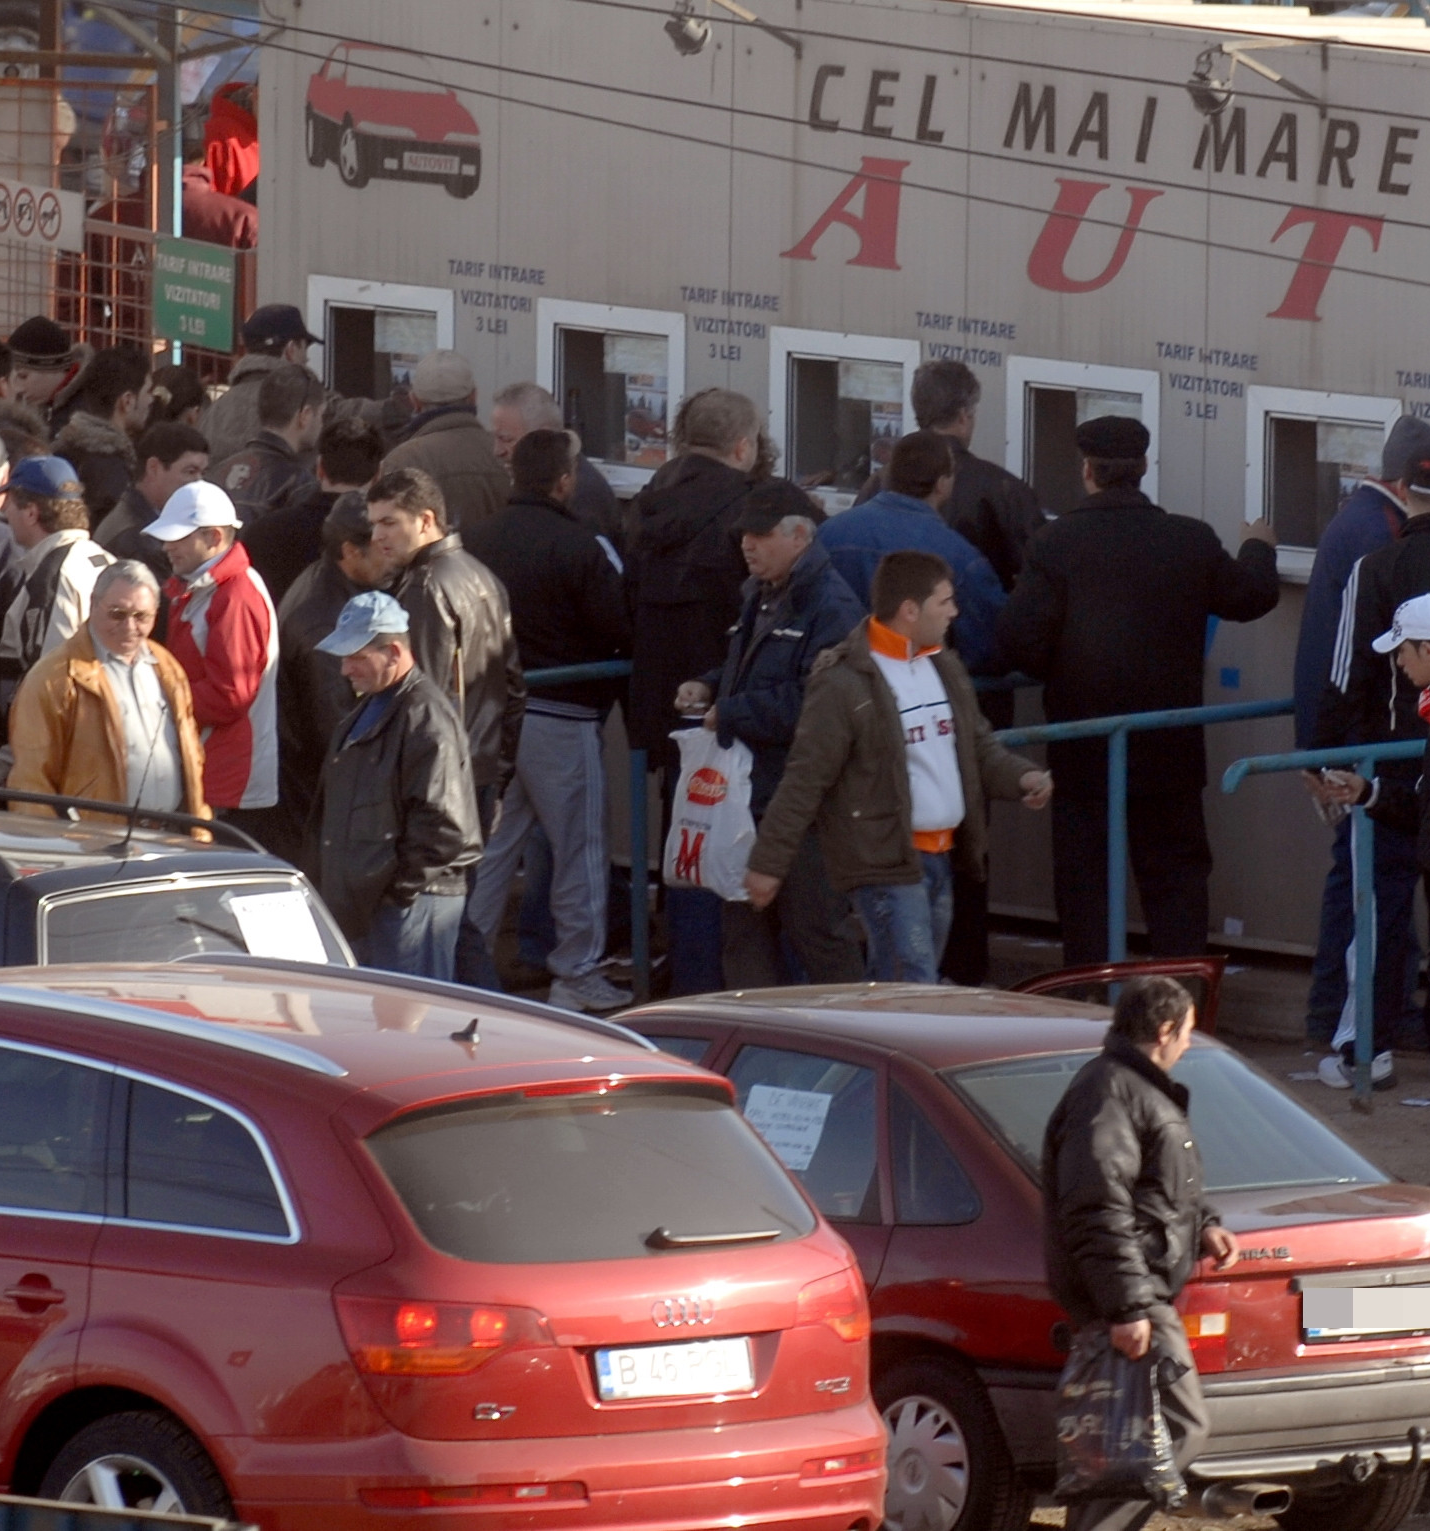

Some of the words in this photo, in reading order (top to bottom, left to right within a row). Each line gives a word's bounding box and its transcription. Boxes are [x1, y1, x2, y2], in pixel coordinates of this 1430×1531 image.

[808, 64, 947, 143] CEL
[1002, 81, 1159, 165] MAI
[1192, 104, 1421, 197] MARE
[448, 259, 485, 278] TARIF
[488, 263, 545, 286] INTRARE
[460, 289, 532, 313] VIZITATORI
[680, 286, 718, 305] TARIF
[721, 290, 780, 313] INTRARE
[475, 316, 484, 333] 3
[487, 318, 508, 335] LEI
[692, 316, 766, 340] VIZITATORI
[915, 311, 953, 331] TARIF
[957, 317, 1017, 341] INTRARE
[708, 343, 716, 359] 3
[720, 345, 741, 361] LEI
[928, 342, 1002, 368] VIZITATORI
[1156, 341, 1195, 362] TARIF
[1168, 372, 1244, 398] VIZITATORI
[1184, 401, 1192, 417] 3
[1196, 403, 1218, 420] LEI
[618, 1353, 638, 1386] B
